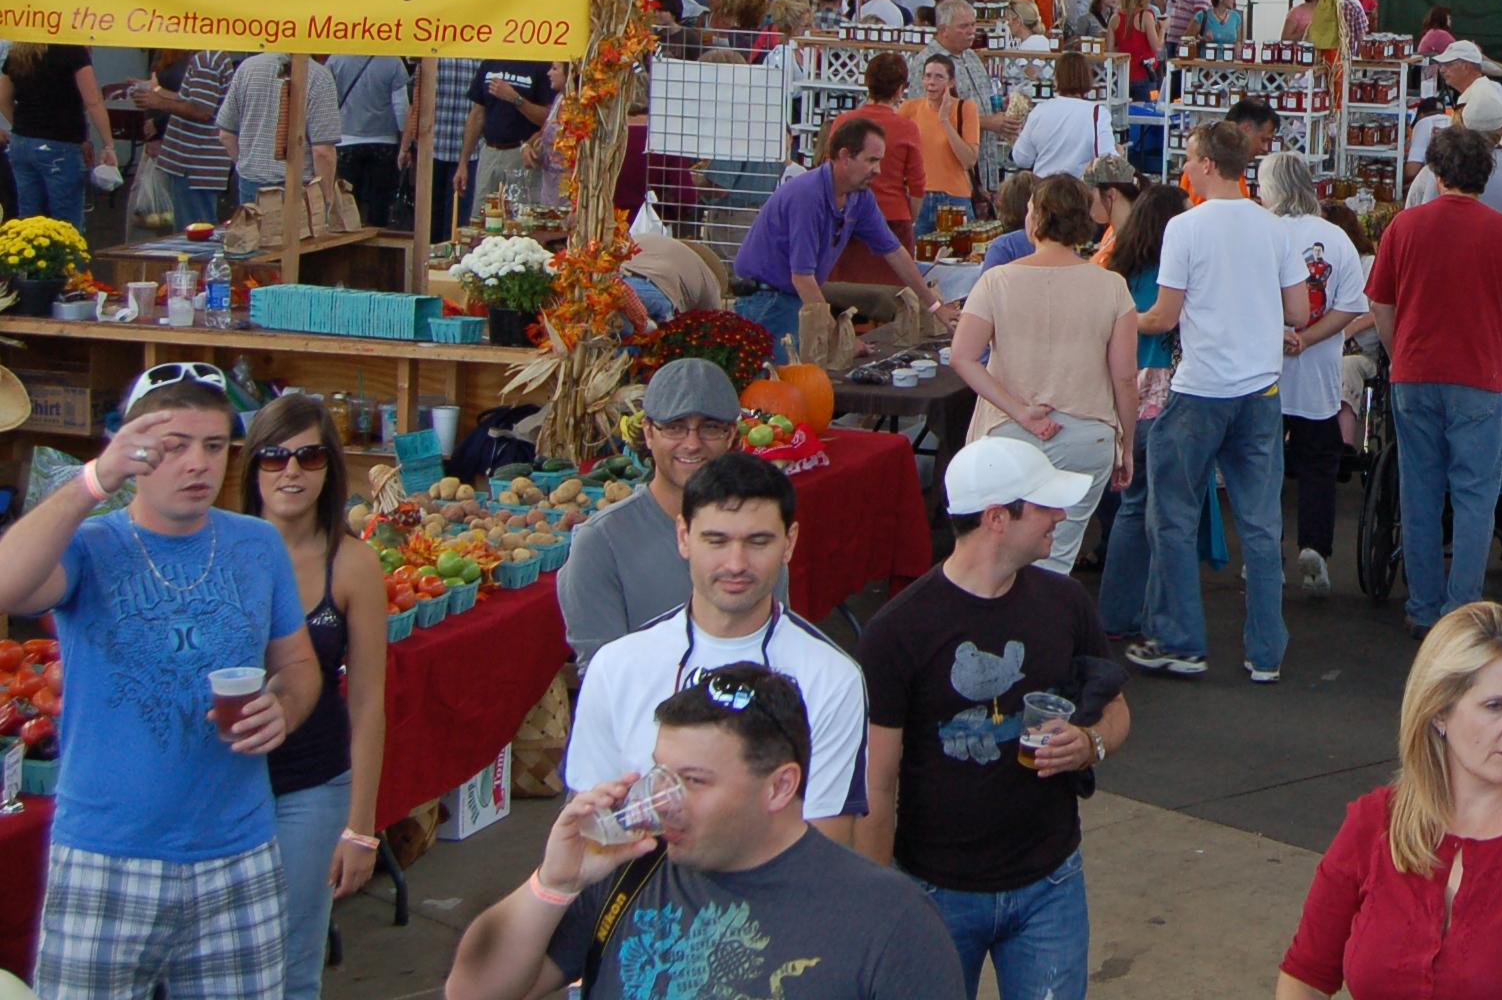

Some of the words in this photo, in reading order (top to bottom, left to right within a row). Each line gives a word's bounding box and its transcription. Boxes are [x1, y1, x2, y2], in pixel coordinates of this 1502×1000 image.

[71, 6, 115, 31] the
[127, 7, 297, 44] Chattanooga
[308, 15, 403, 42] Market
[412, 17, 493, 43] Since
[502, 19, 570, 46] 2002
[596, 892, 627, 943] Nikon
